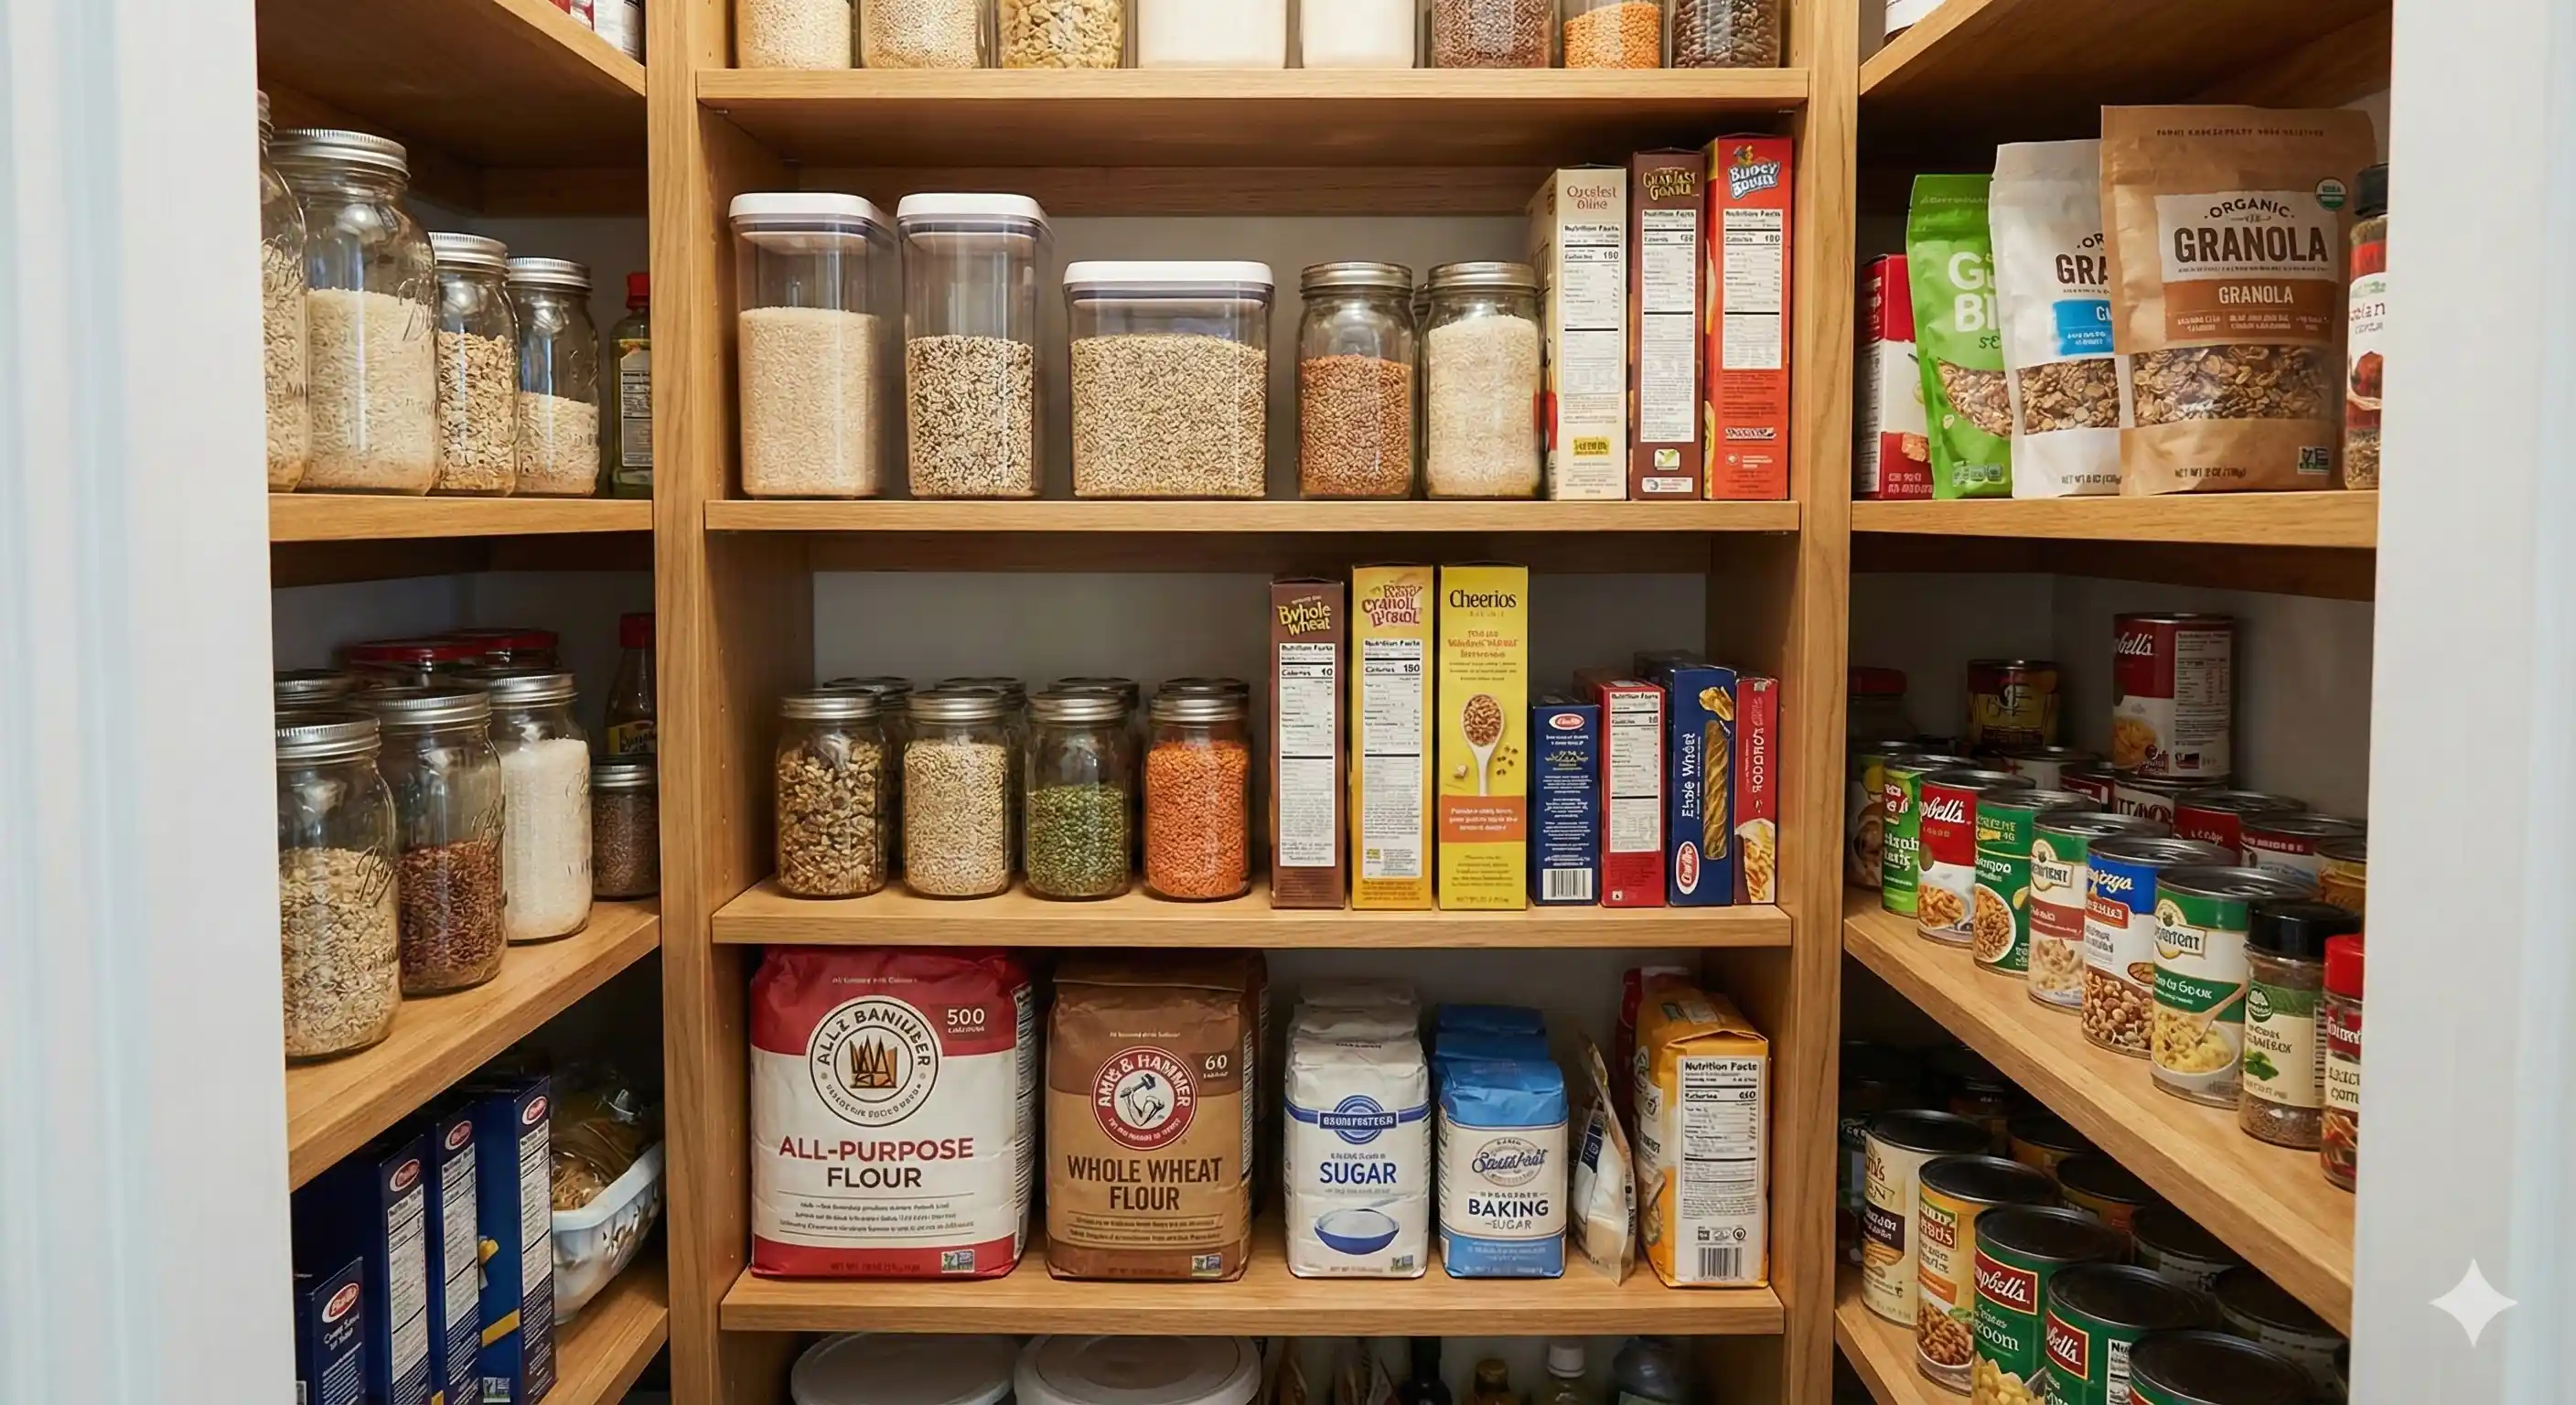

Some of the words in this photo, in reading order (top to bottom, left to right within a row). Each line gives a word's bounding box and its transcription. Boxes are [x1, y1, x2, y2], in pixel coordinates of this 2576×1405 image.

[2209, 198, 2292, 219] ORGANIC
[2174, 227, 2328, 263] GRANOLA
[2218, 285, 2294, 304] GRANOLA
[1449, 589, 1518, 608] Cheerios
[1403, 664, 1421, 672] 150
[947, 1008, 985, 1025] 500
[1205, 1054, 1228, 1070] 60
[1137, 1054, 1191, 1108] HAMMER
[778, 1136, 974, 1162] ALL-PURPOSE
[827, 1168, 922, 1188] FLOUR
[1068, 1154, 1142, 1183] WHOLE
[1147, 1156, 1223, 1184] WHEAT
[1319, 1162, 1397, 1185] SUGAR
[1110, 1186, 1181, 1211] FLOUR
[1468, 1198, 1549, 1218] BAKING
